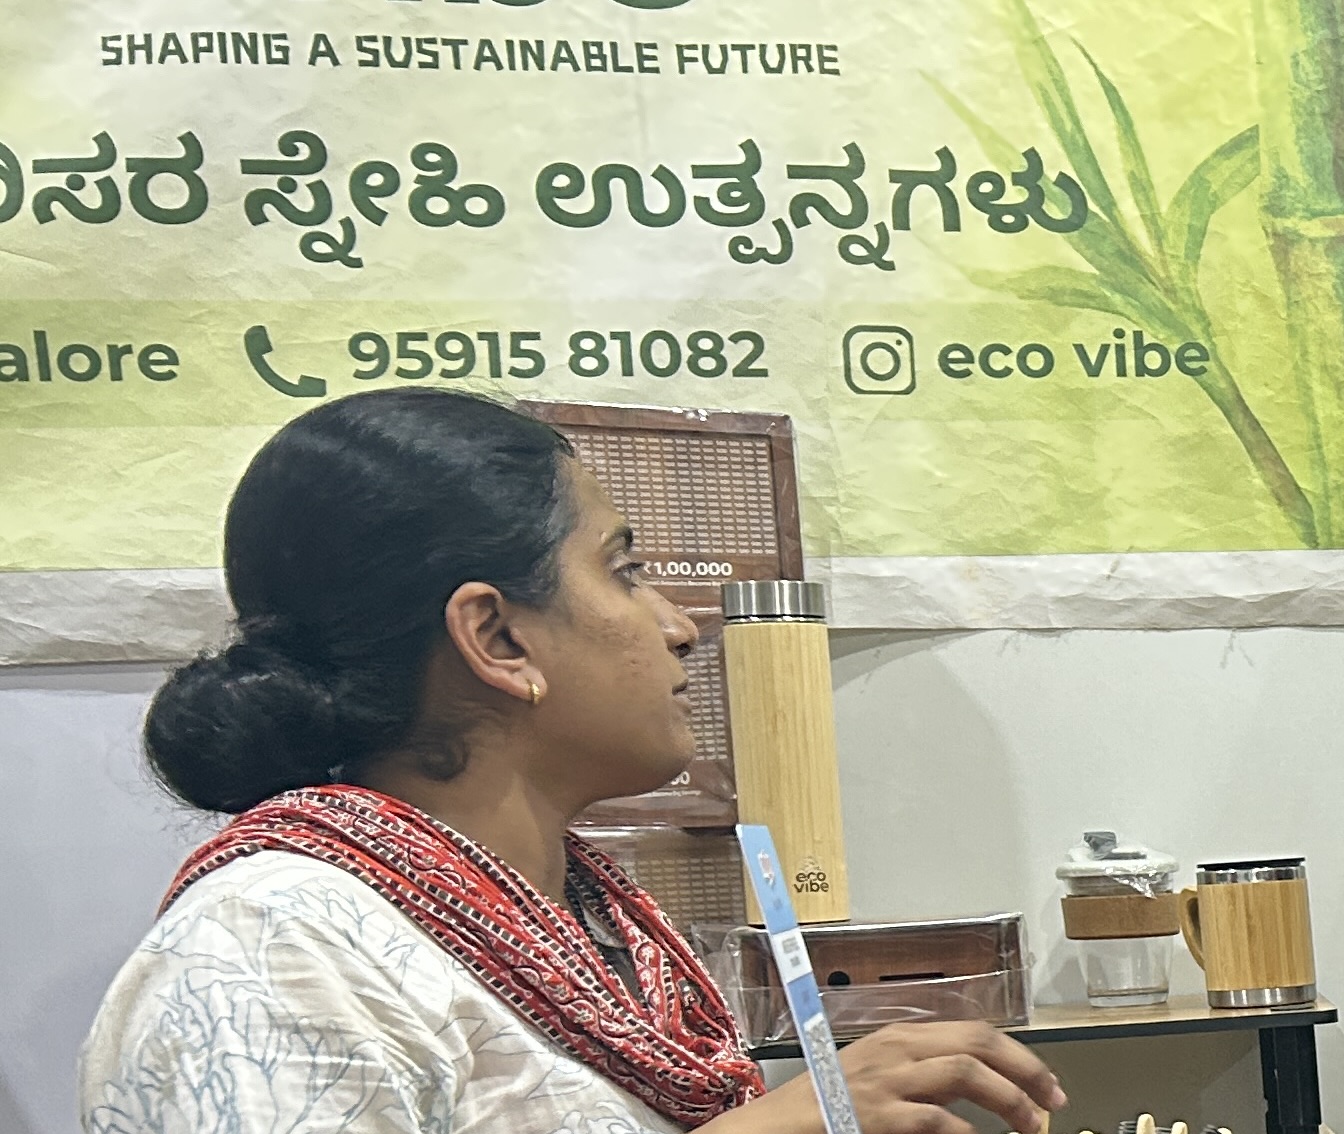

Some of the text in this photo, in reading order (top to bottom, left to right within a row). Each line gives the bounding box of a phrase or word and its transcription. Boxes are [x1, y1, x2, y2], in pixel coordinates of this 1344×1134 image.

[101, 31, 841, 77] SHAPING A SUSTAINABLE FUTURE
[239, 129, 507, 269] ಸ್ನೇಹಿ
[534, 138, 1090, 272] ಉತ್ಪನ್ನಗಳು
[347, 329, 547, 381] 95915
[567, 329, 770, 379] 81082
[938, 340, 1055, 380] eco
[1073, 328, 1210, 380] vibe
[793, 879, 830, 893] vibe
[795, 871, 827, 883] eco
